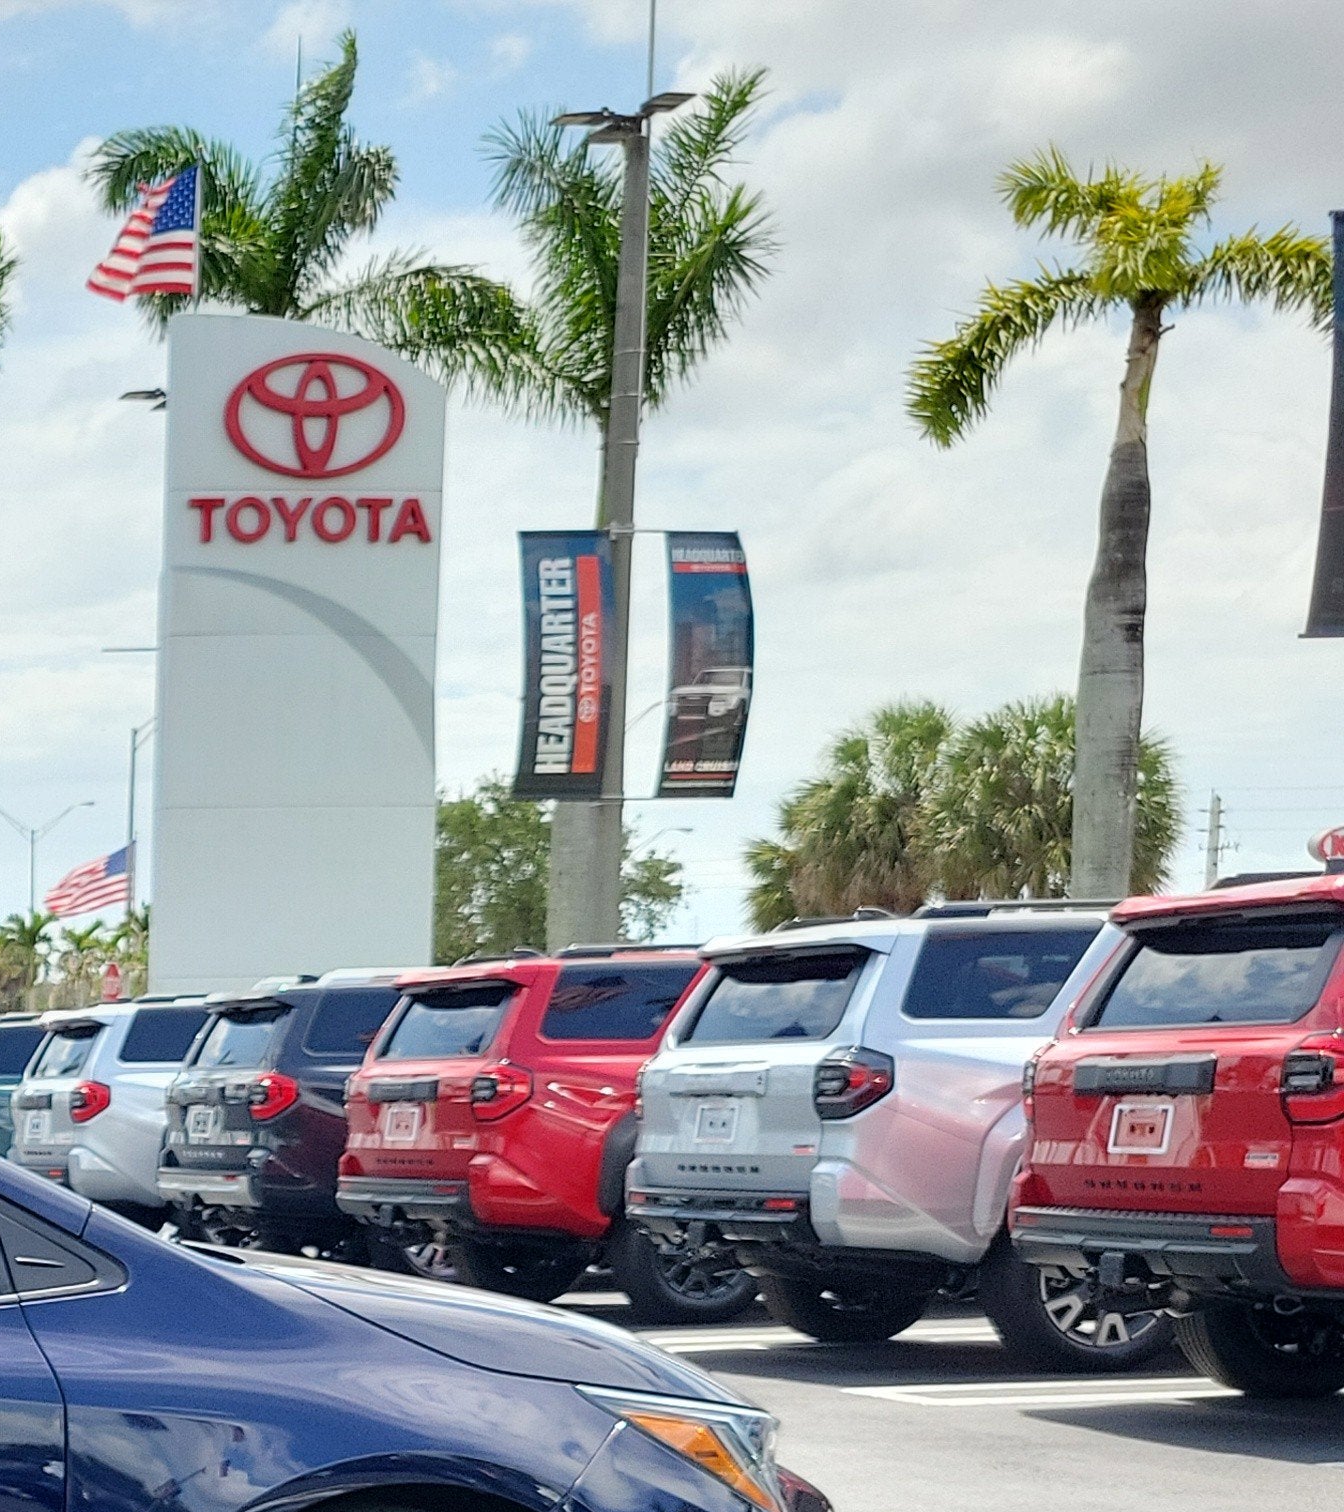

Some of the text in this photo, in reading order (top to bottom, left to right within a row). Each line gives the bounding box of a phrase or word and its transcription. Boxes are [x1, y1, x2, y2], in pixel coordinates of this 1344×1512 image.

[188, 497, 432, 543] TOYOTA
[534, 556, 578, 774] HEADQUARTER
[579, 611, 600, 697] TOYOTA
